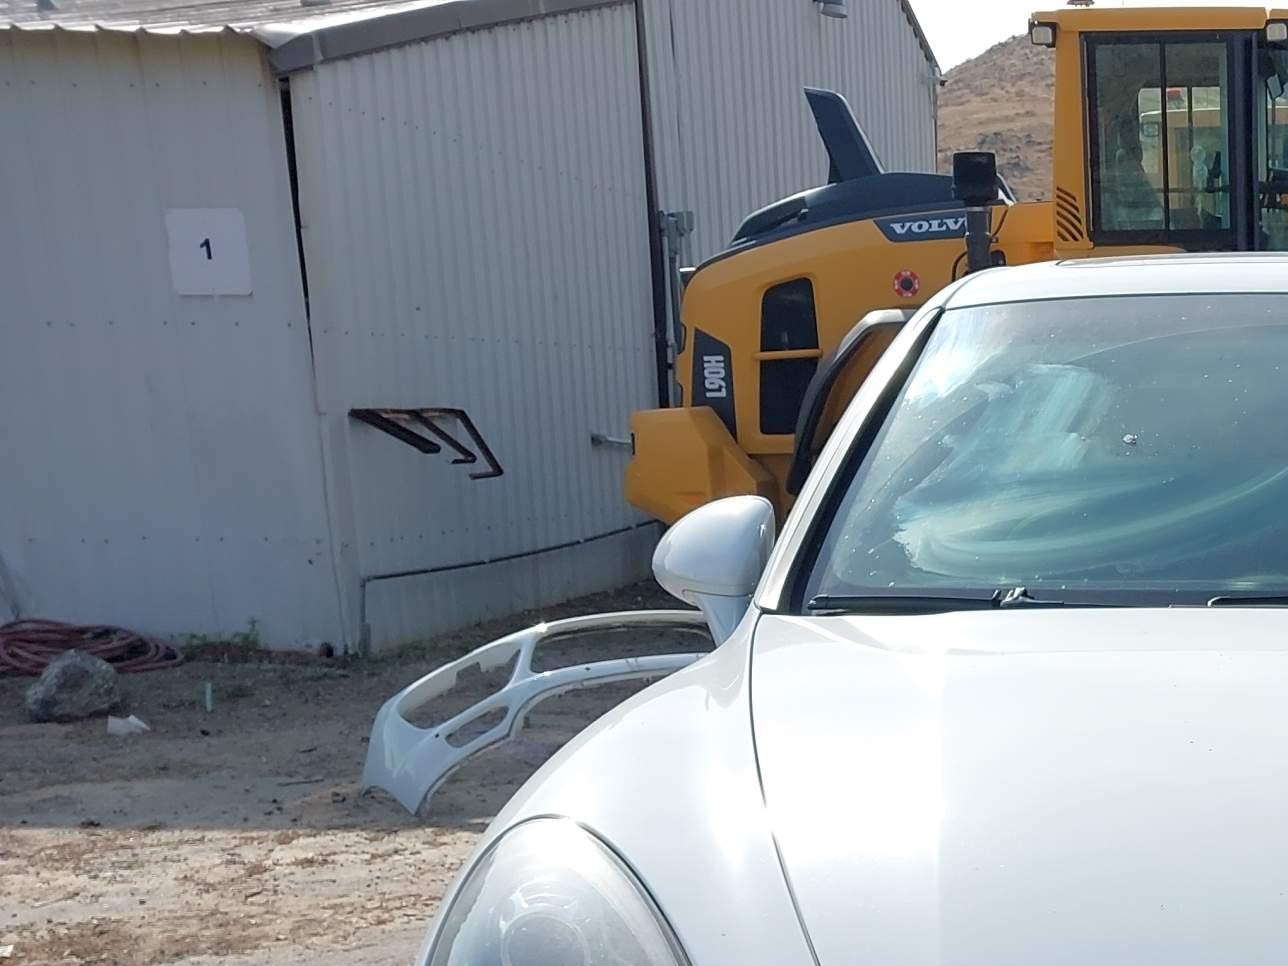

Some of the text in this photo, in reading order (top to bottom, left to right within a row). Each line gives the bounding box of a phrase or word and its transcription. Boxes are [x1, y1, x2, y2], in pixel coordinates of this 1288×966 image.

[889, 217, 967, 235] VOLV
[200, 238, 212, 260] 1
[703, 355, 727, 398] L90H
